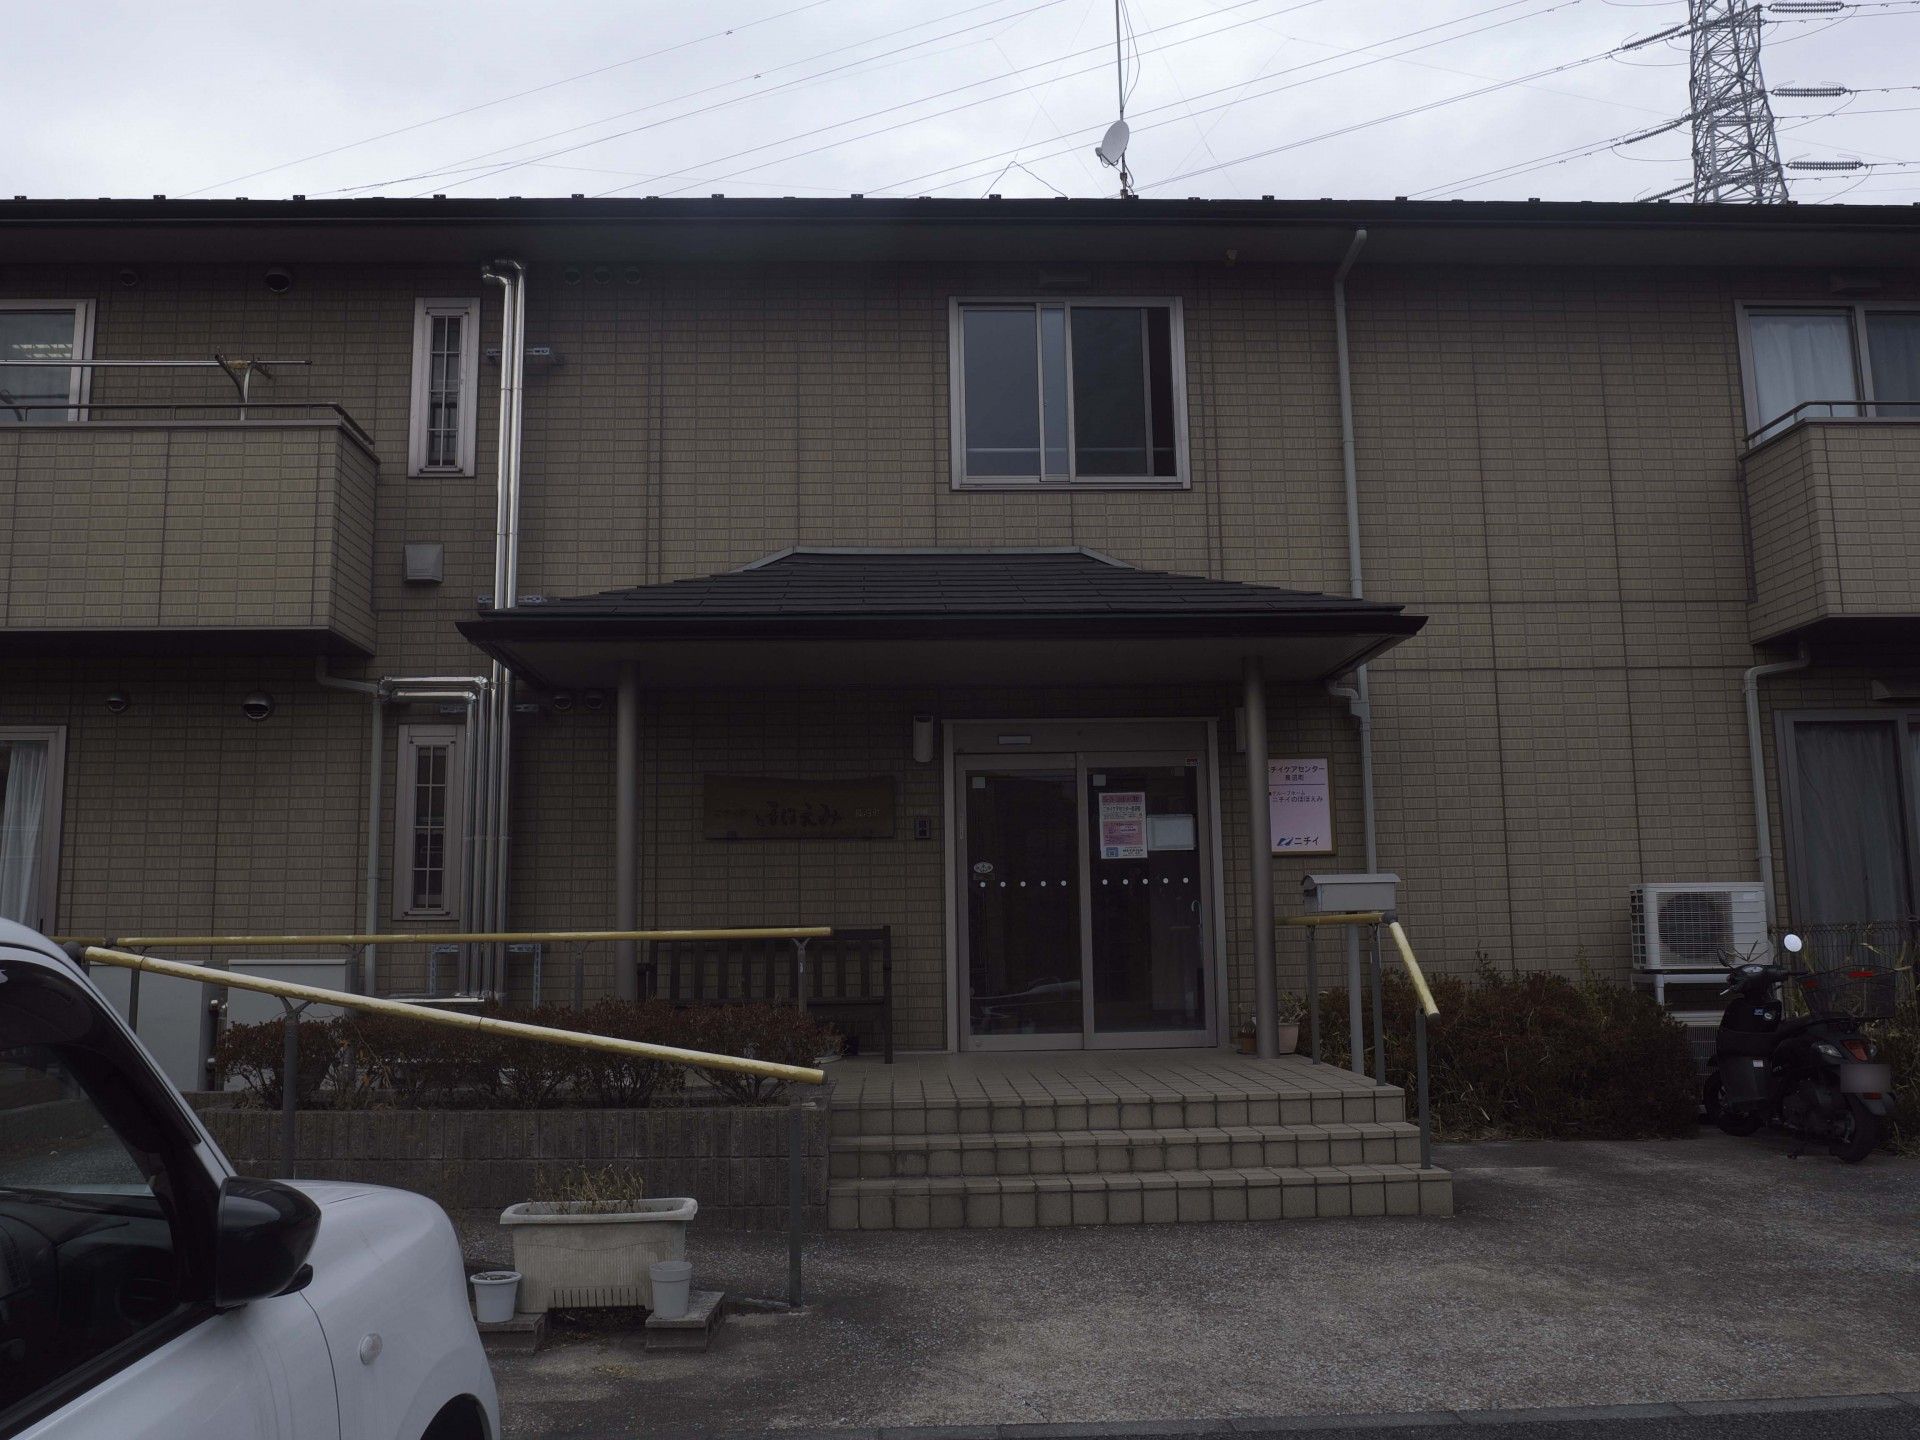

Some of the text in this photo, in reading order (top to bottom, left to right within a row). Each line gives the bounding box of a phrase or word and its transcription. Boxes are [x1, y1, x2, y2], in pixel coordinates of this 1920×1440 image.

[1270, 765, 1325, 773] チイケアセンター
[1294, 836, 1319, 846] ニチイ
